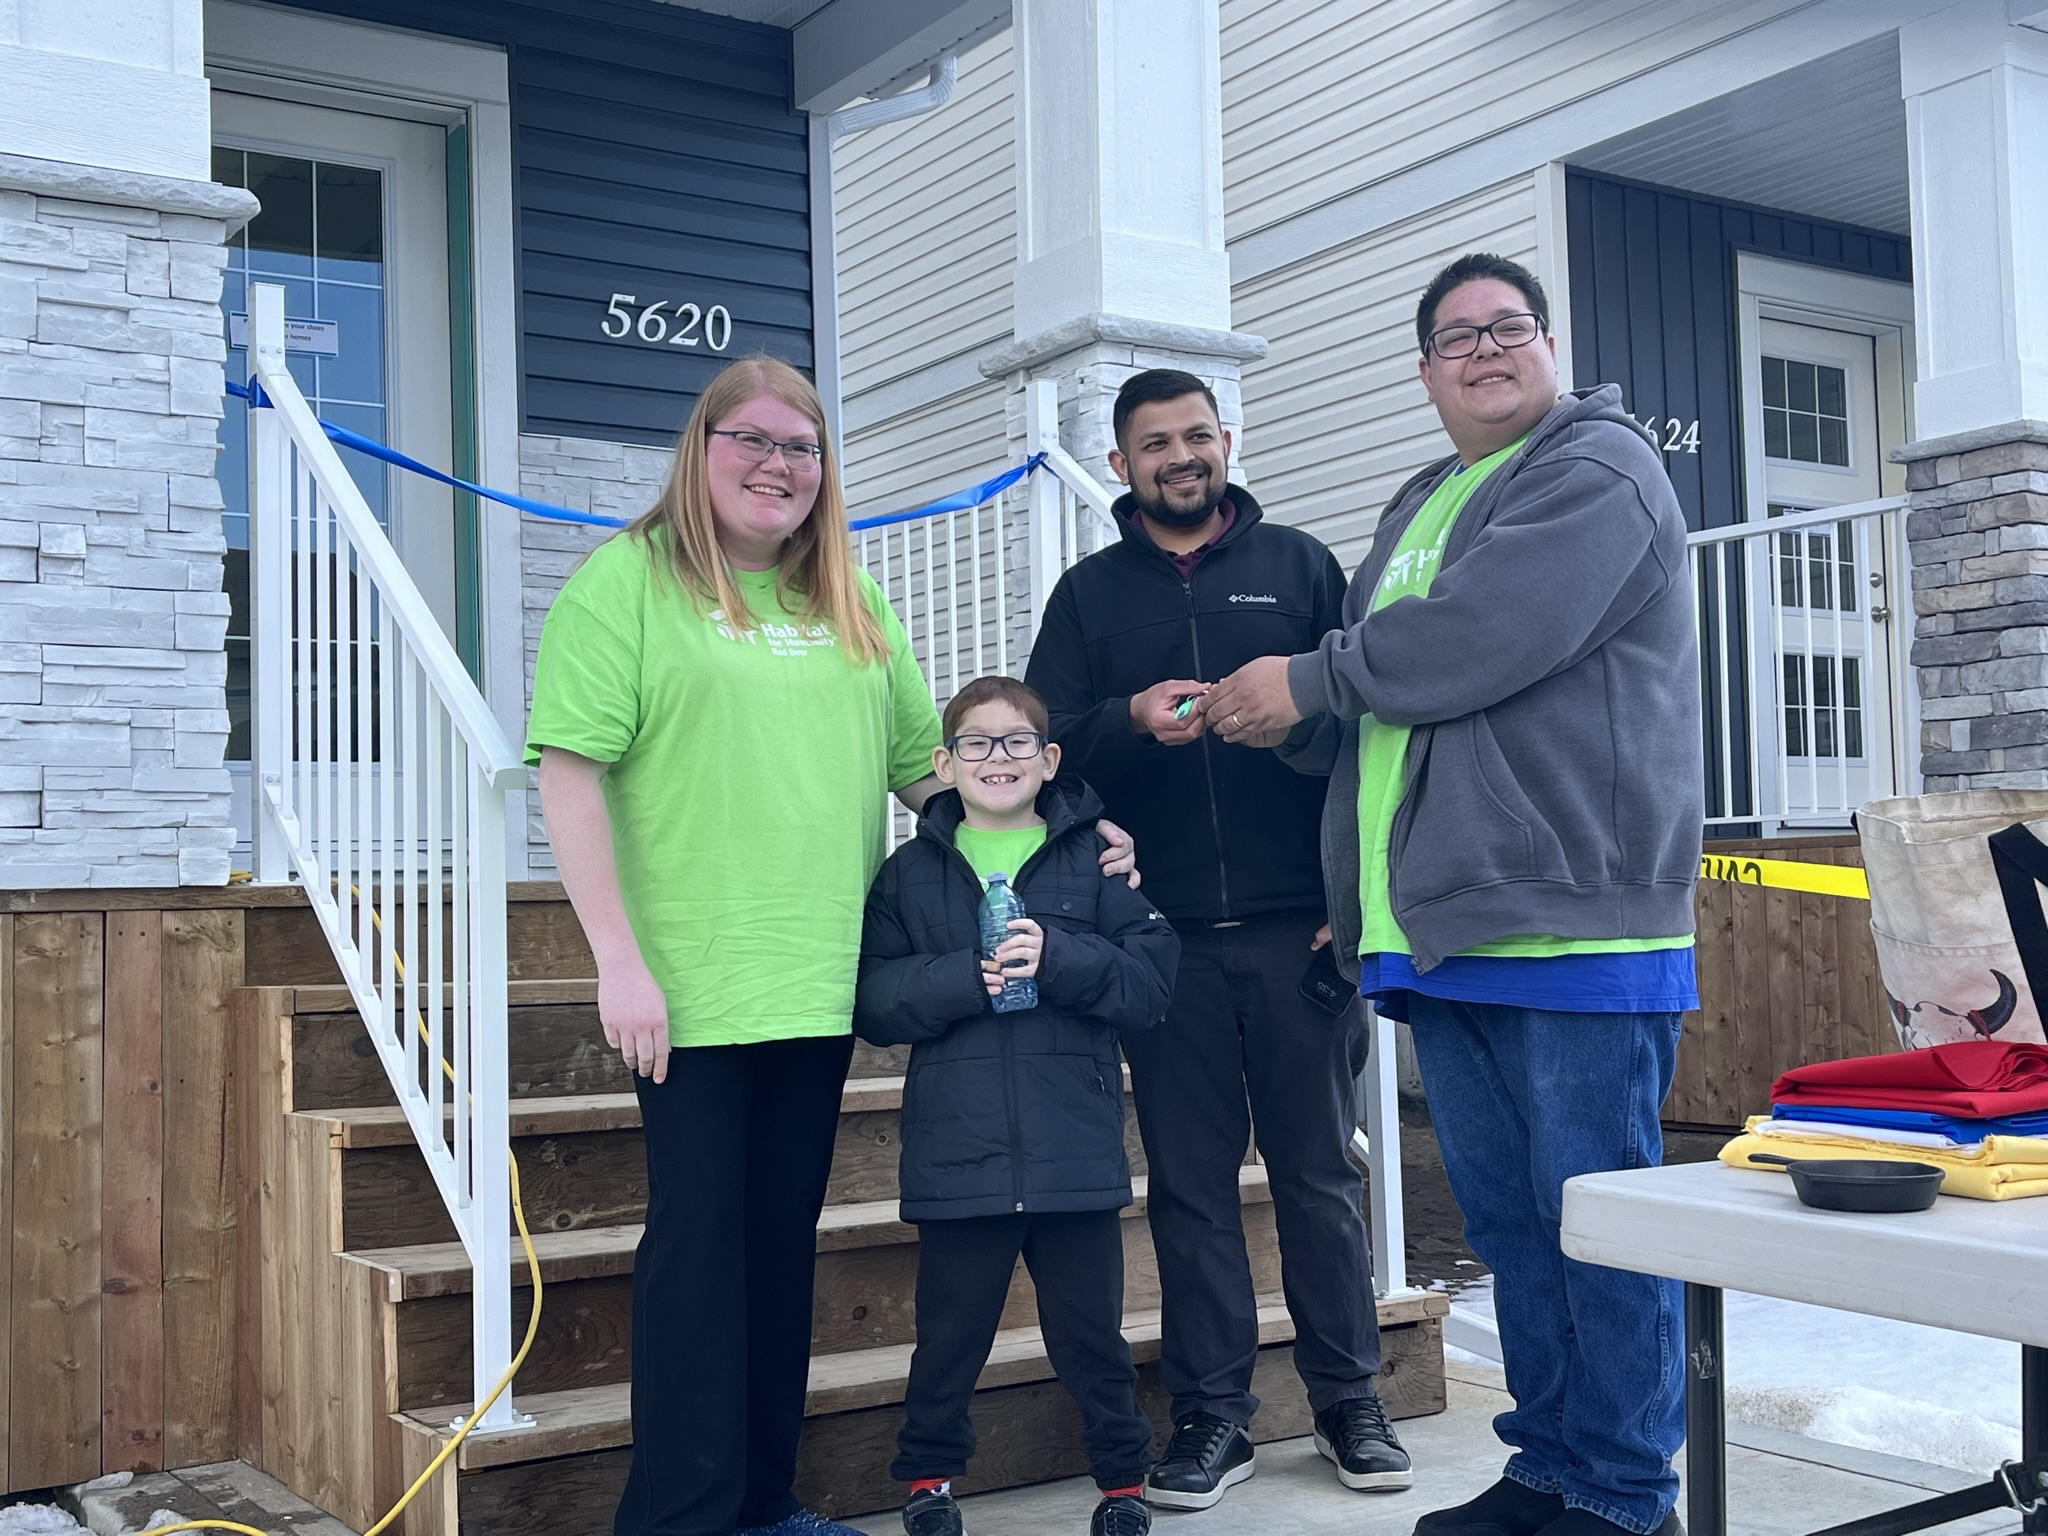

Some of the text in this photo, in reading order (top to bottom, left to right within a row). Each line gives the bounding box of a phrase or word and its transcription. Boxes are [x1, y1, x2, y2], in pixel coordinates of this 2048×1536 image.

[601, 293, 731, 351] 5620
[290, 333, 311, 341] homes
[1626, 413, 1700, 453] 624
[1238, 594, 1277, 603] Columbia
[767, 638, 782, 646] for
[771, 648, 807, 656] Red Deer
[1317, 981, 1337, 997] 4:35
